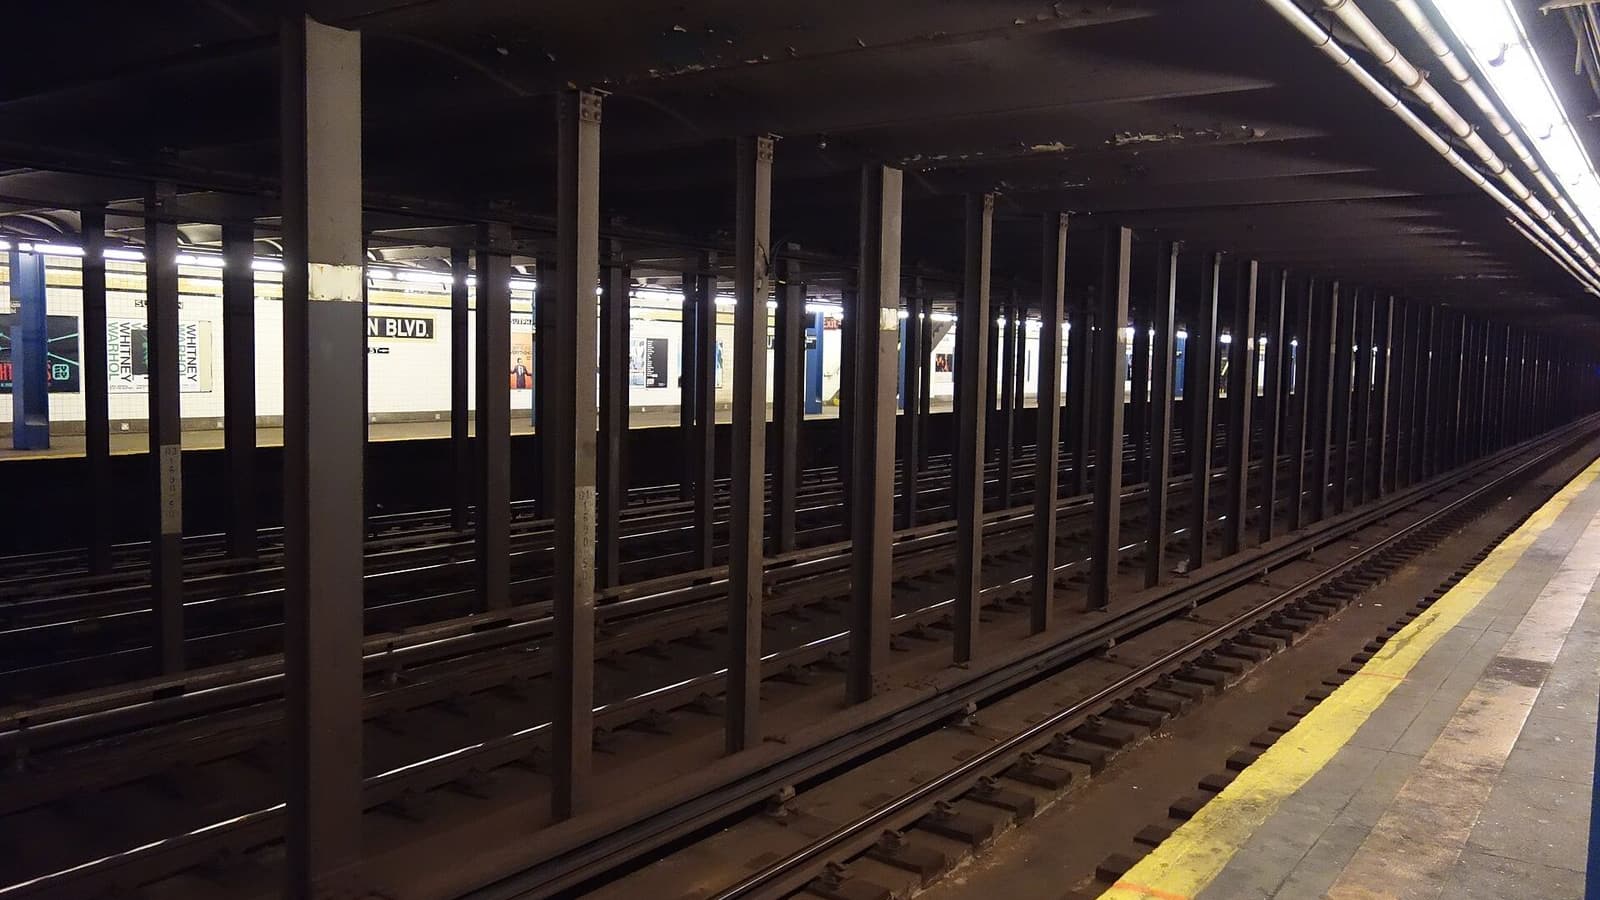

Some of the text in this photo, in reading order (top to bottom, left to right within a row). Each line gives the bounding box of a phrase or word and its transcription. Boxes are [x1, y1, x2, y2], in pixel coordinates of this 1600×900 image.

[108, 322, 120, 380] WARHOL
[120, 322, 132, 382] WHITNEY
[186, 324, 198, 382] WHITNEY
[386, 318, 430, 337] BLVD.
